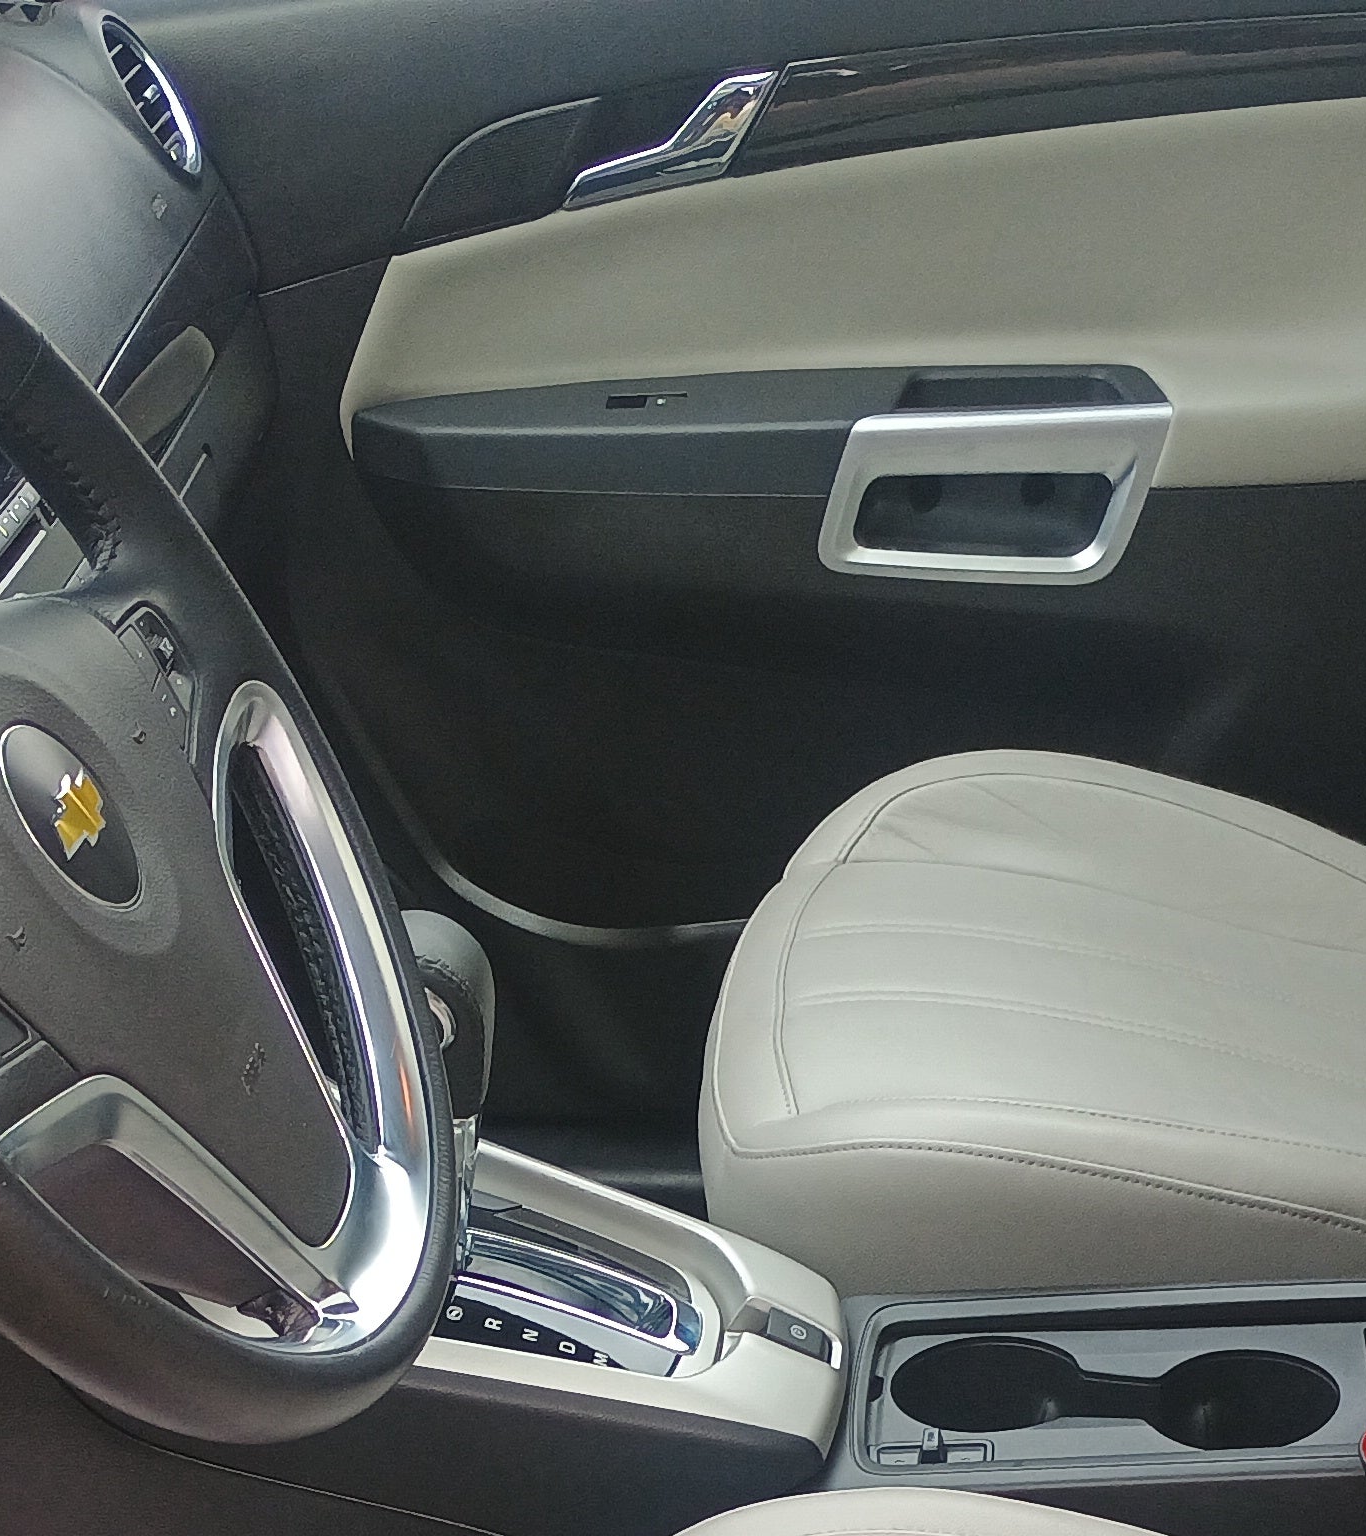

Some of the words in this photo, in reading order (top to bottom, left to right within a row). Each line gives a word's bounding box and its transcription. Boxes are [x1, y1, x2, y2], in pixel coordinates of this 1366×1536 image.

[484, 1317, 502, 1330] R
[522, 1328, 538, 1341] N
[559, 1341, 575, 1354] D
